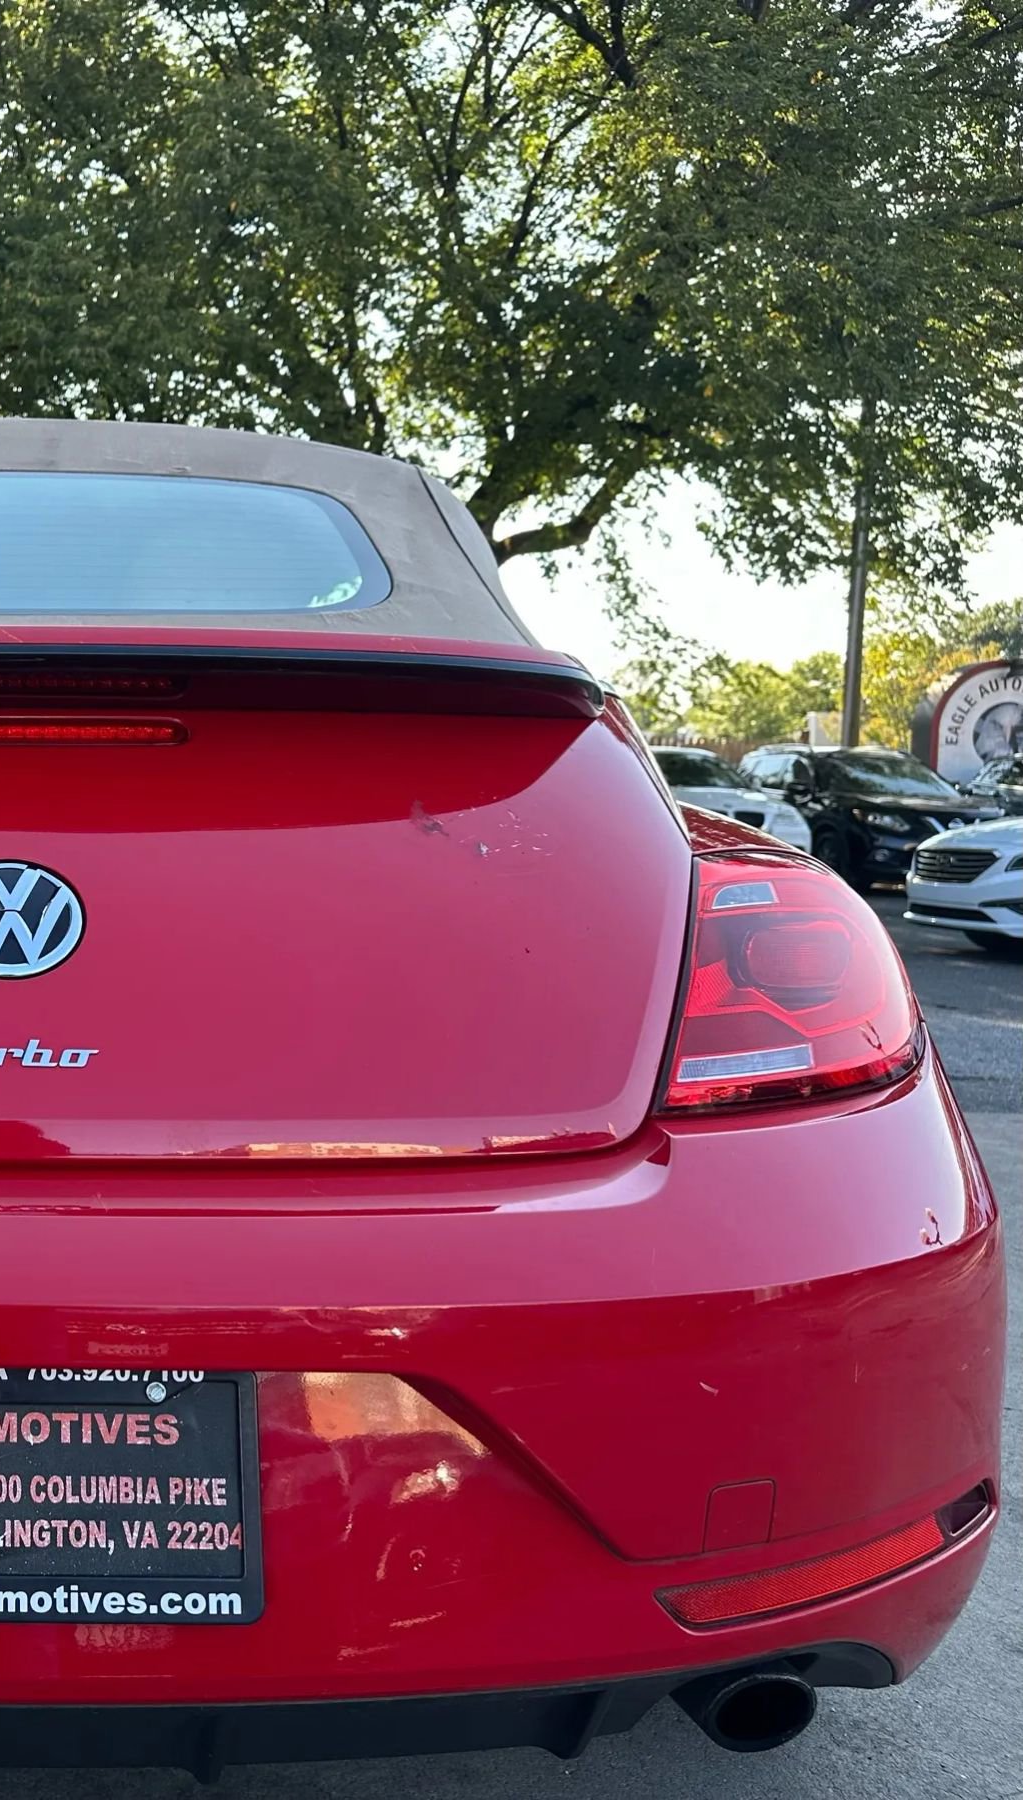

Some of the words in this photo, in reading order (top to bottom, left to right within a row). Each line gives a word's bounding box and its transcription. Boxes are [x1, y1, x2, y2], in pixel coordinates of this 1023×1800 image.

[945, 694, 977, 746] EAGLE
[978, 676, 1023, 698] AUTO
[30, 1475, 161, 1505] COLUMBIA
[169, 1477, 227, 1506] PIKE
[123, 1521, 159, 1549] VA
[167, 1521, 243, 1550] 22204
